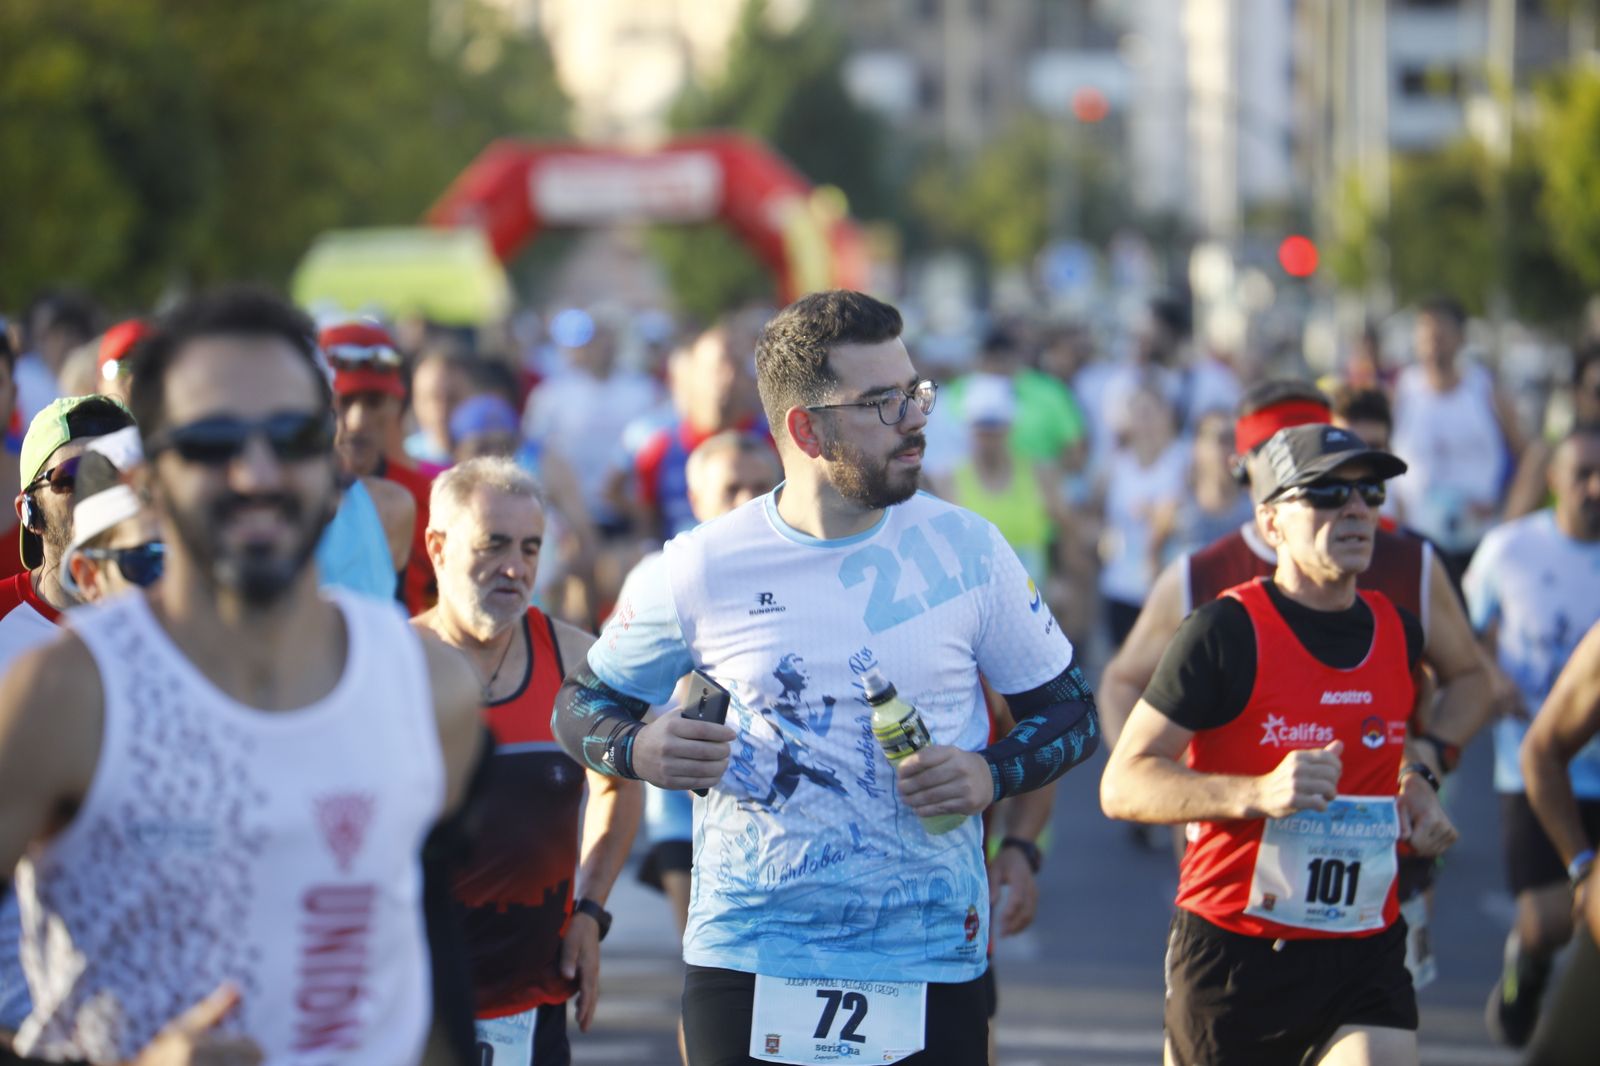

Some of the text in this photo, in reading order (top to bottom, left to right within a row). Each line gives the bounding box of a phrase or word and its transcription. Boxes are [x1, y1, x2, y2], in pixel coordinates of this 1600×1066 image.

[1274, 818, 1325, 835] MEDIA
[1306, 857, 1361, 907] 101
[875, 983, 899, 997] CRESPO
[813, 989, 868, 1044] 72
